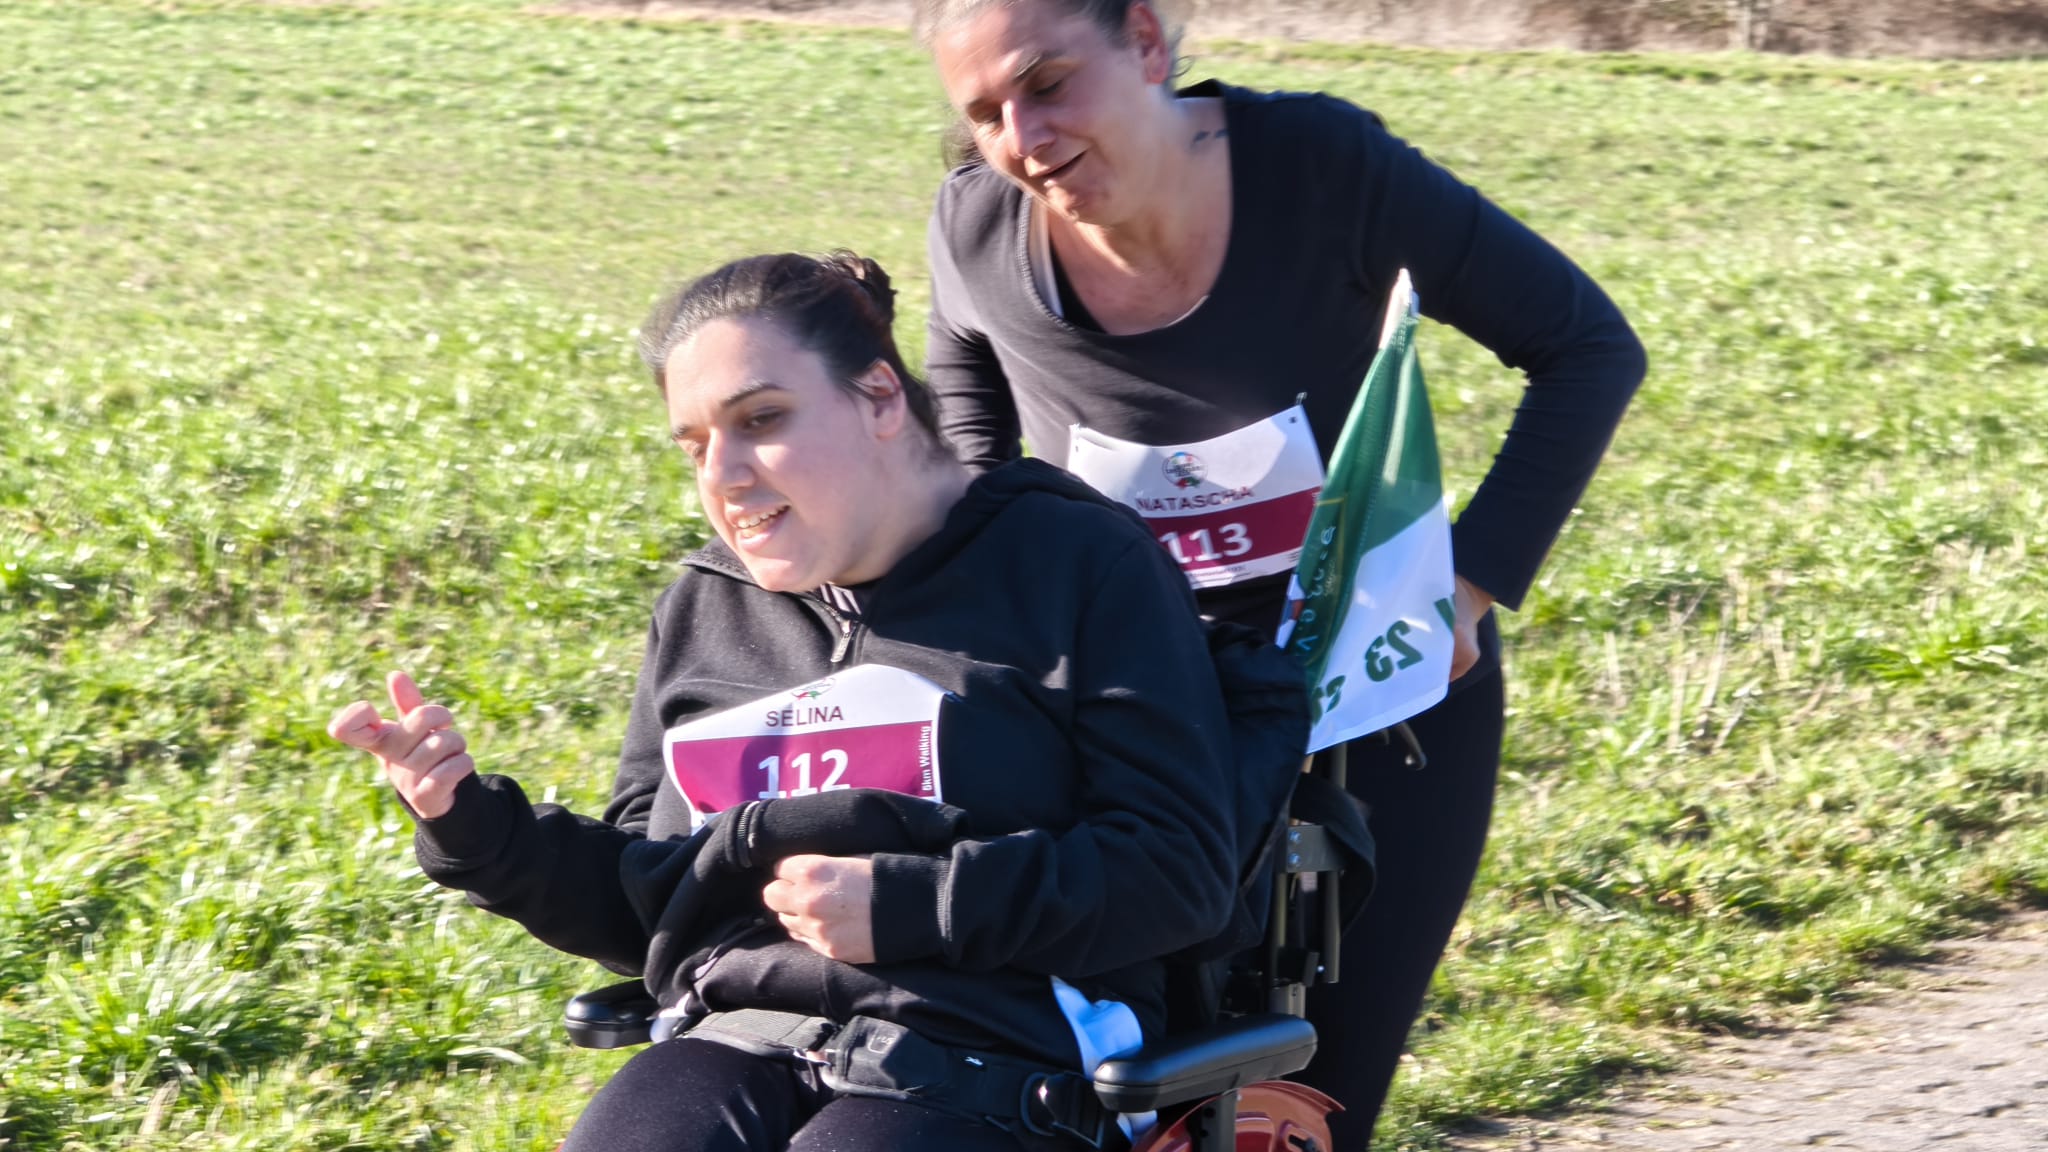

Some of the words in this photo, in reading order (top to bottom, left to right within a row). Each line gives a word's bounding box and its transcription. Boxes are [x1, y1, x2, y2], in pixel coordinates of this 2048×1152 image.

[1134, 486, 1255, 511] NATASCHA
[1159, 523, 1253, 564] 113
[766, 706, 844, 727] SELINA
[919, 725, 933, 767] Walking
[758, 749, 850, 799] 112
